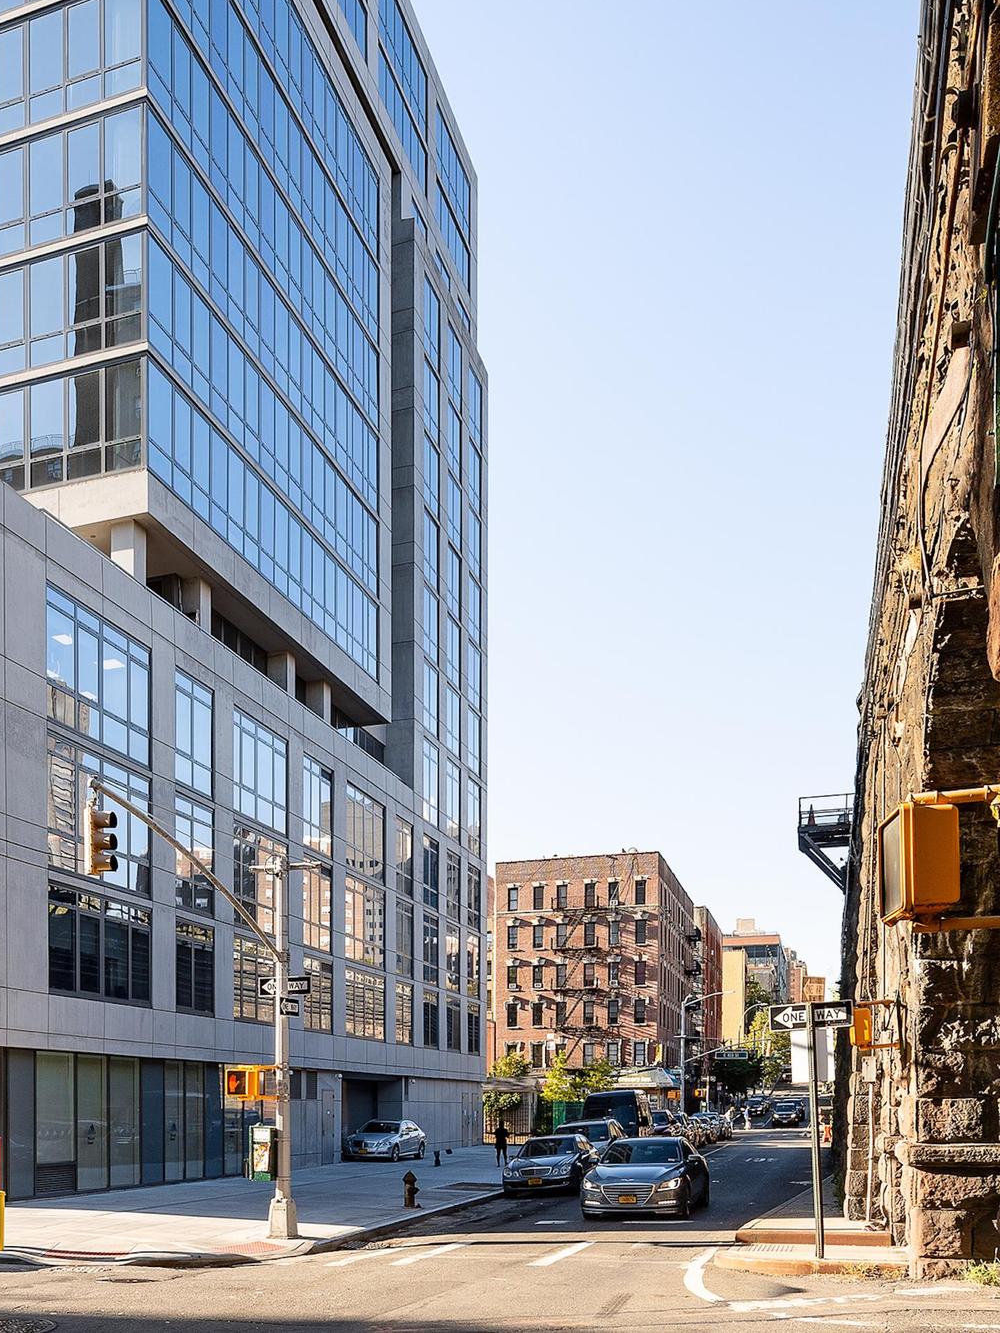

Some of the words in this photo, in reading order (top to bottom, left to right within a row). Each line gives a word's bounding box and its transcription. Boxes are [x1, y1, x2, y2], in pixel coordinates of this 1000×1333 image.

[288, 981, 304, 989] WAY
[782, 1011, 805, 1023] ONE
[816, 1009, 841, 1020] WAY
